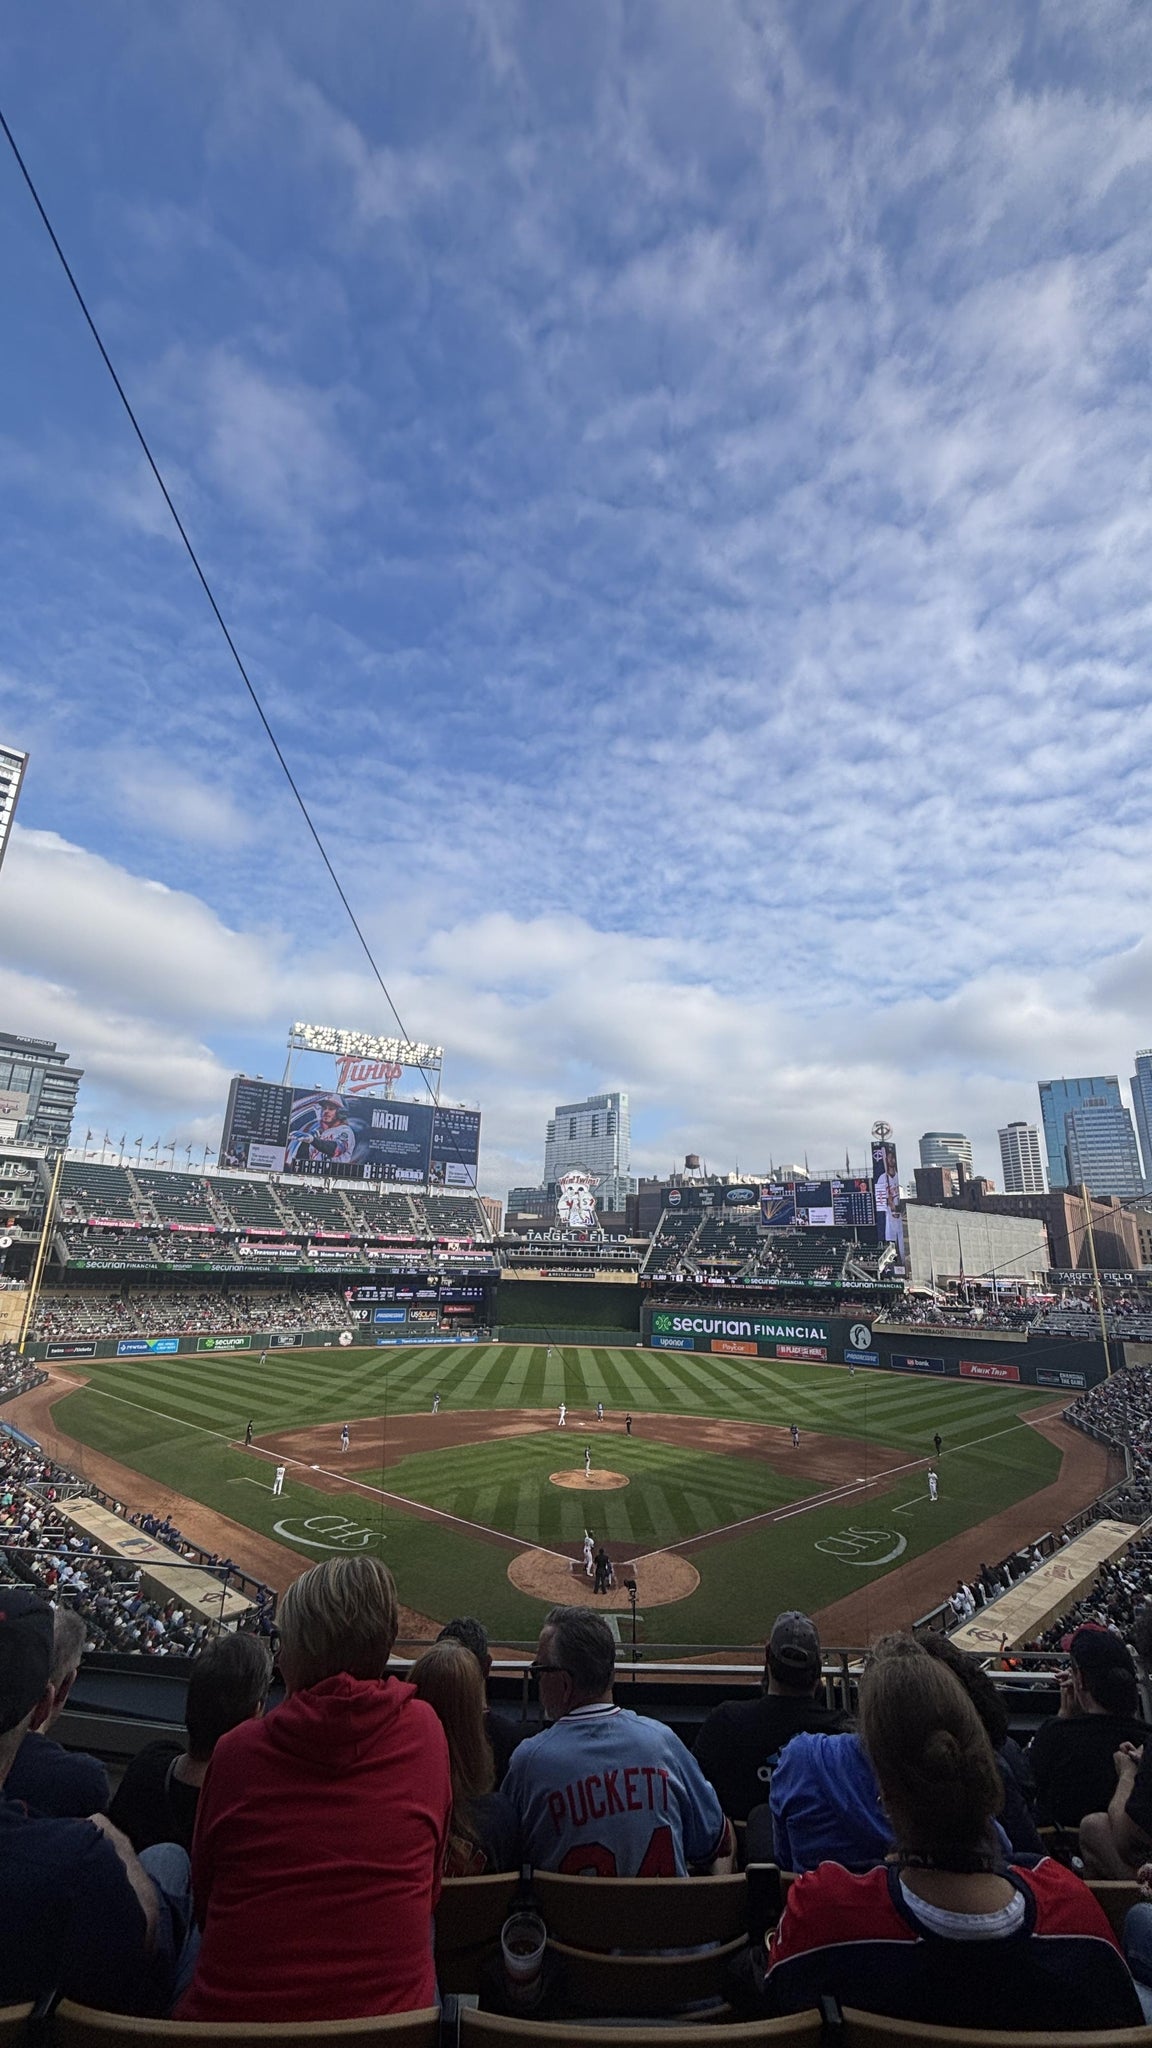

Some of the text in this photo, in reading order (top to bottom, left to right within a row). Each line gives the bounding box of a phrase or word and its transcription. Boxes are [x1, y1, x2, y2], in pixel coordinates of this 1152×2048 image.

[336, 1056, 402, 1085] Twins
[371, 1111, 409, 1131] MARTIN
[560, 1175, 599, 1185] Win! Twins!
[527, 1232, 627, 1242] TARGET FIELD
[673, 1318, 827, 1340] securian FINANCIAL
[660, 1338, 684, 1347] uponor
[722, 1343, 744, 1351] Paycor
[304, 1515, 387, 1546] CHS
[814, 1527, 891, 1556] CHS
[548, 1767, 669, 1836] PUCKETT
